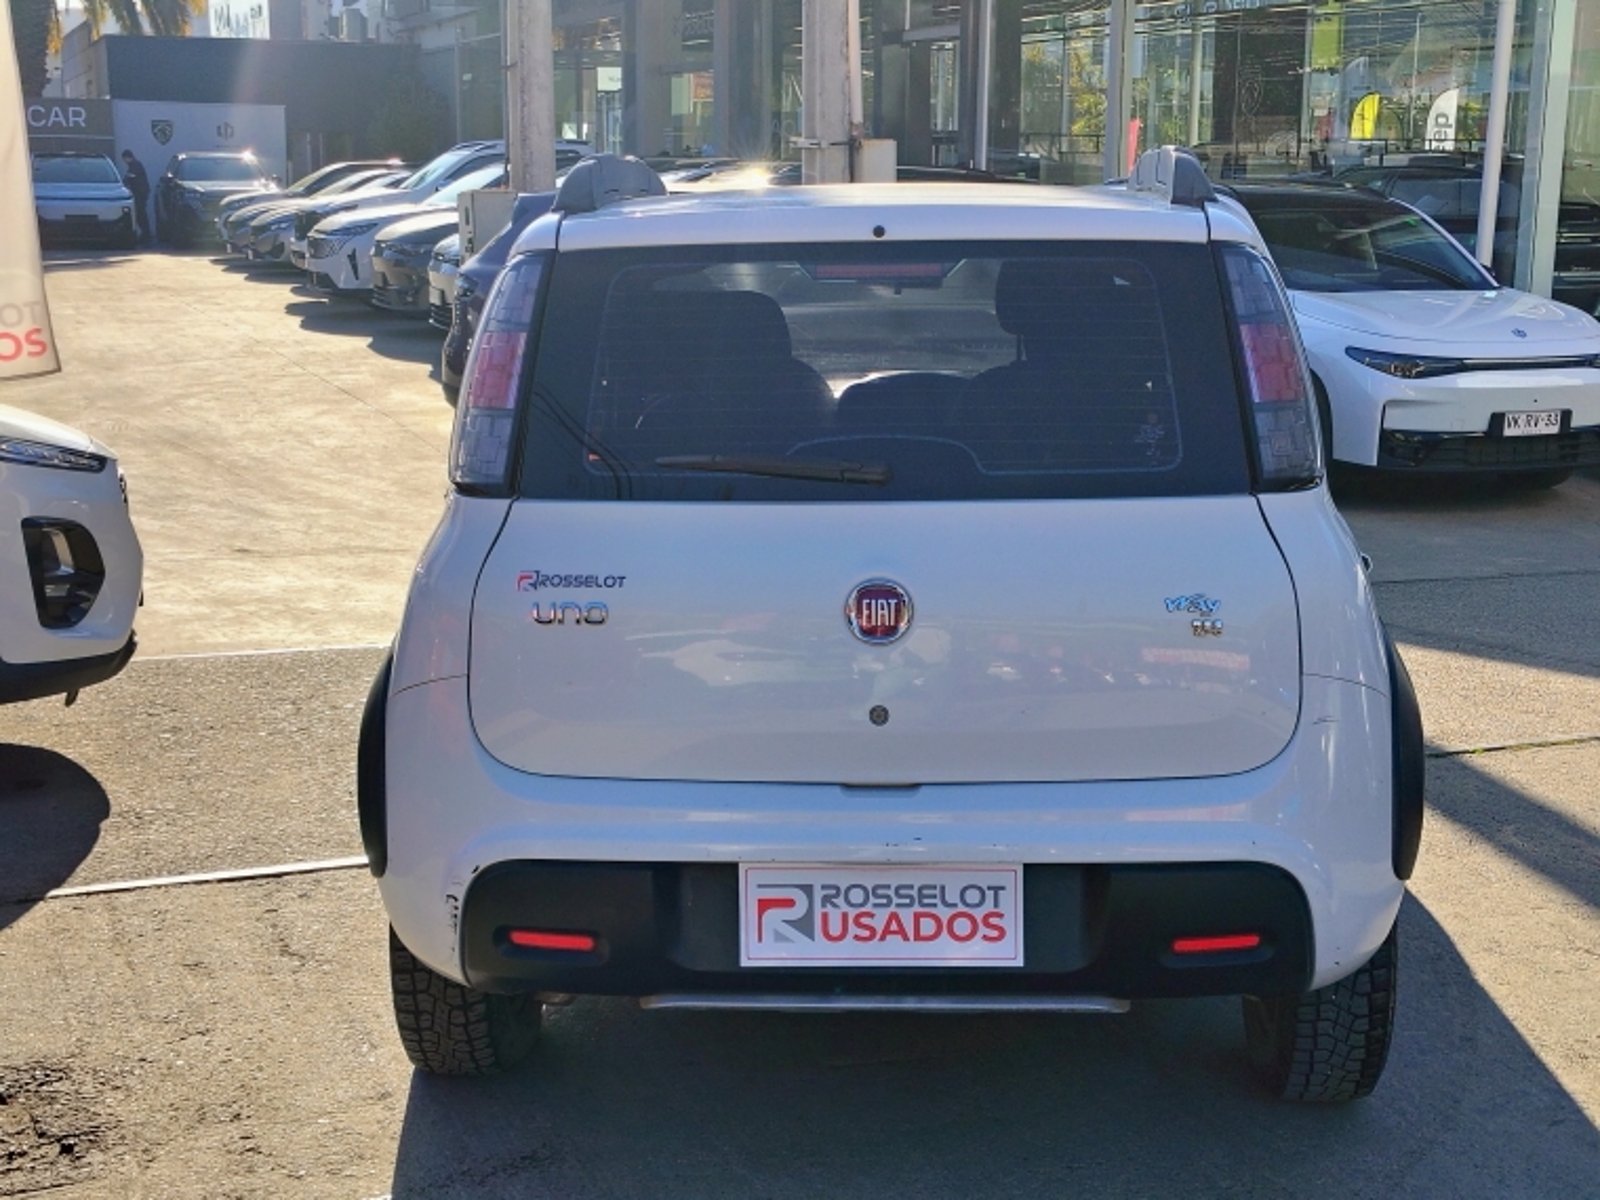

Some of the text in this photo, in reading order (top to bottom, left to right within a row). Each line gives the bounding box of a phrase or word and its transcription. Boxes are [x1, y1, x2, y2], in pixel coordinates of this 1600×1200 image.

[27, 105, 86, 127] CAR
[539, 574, 626, 589] ROSSELOT
[862, 599, 898, 627] FIAT
[820, 884, 1006, 909] ROSSELOT
[820, 911, 1007, 943] USADOS
